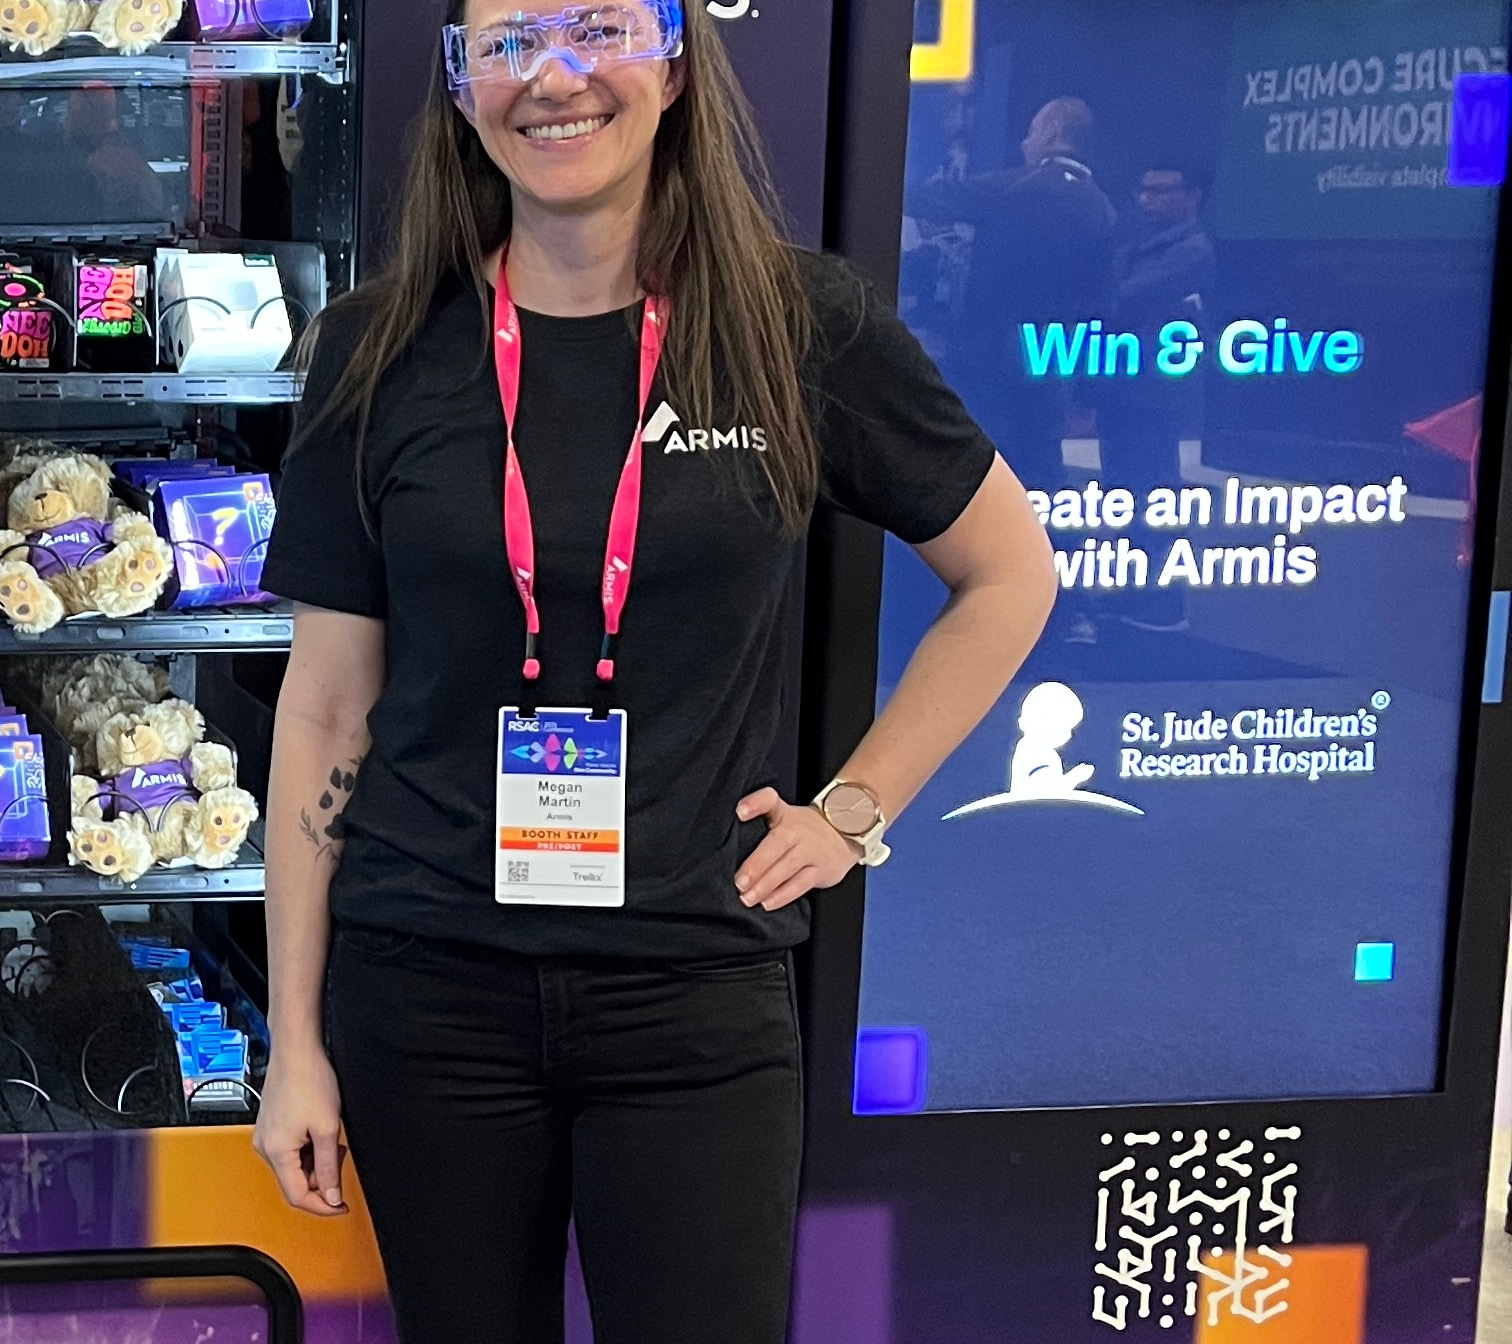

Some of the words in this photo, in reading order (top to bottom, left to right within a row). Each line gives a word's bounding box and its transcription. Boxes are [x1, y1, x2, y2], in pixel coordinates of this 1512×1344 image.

[1, 310, 52, 340] NEE
[0, 331, 49, 360] DOH
[1023, 319, 1142, 376] Win
[1155, 320, 1204, 375] &
[1219, 317, 1363, 374] Give
[663, 425, 767, 454] ARMIS
[1026, 479, 1136, 528] eate
[1144, 488, 1211, 526] an
[1224, 476, 1408, 534] Impact
[1052, 537, 1149, 588] with
[1157, 534, 1319, 587] Armis
[603, 563, 617, 604] ARMIS
[507, 721, 540, 732] RSAC
[1121, 712, 1160, 742] St.
[1158, 710, 1229, 749] Jude
[1118, 744, 1249, 779] Research
[1251, 741, 1376, 782] Hospital
[537, 780, 584, 795] Megan
[538, 795, 582, 808] Martin
[521, 829, 561, 839] BOOTH
[566, 830, 599, 840] STAFF
